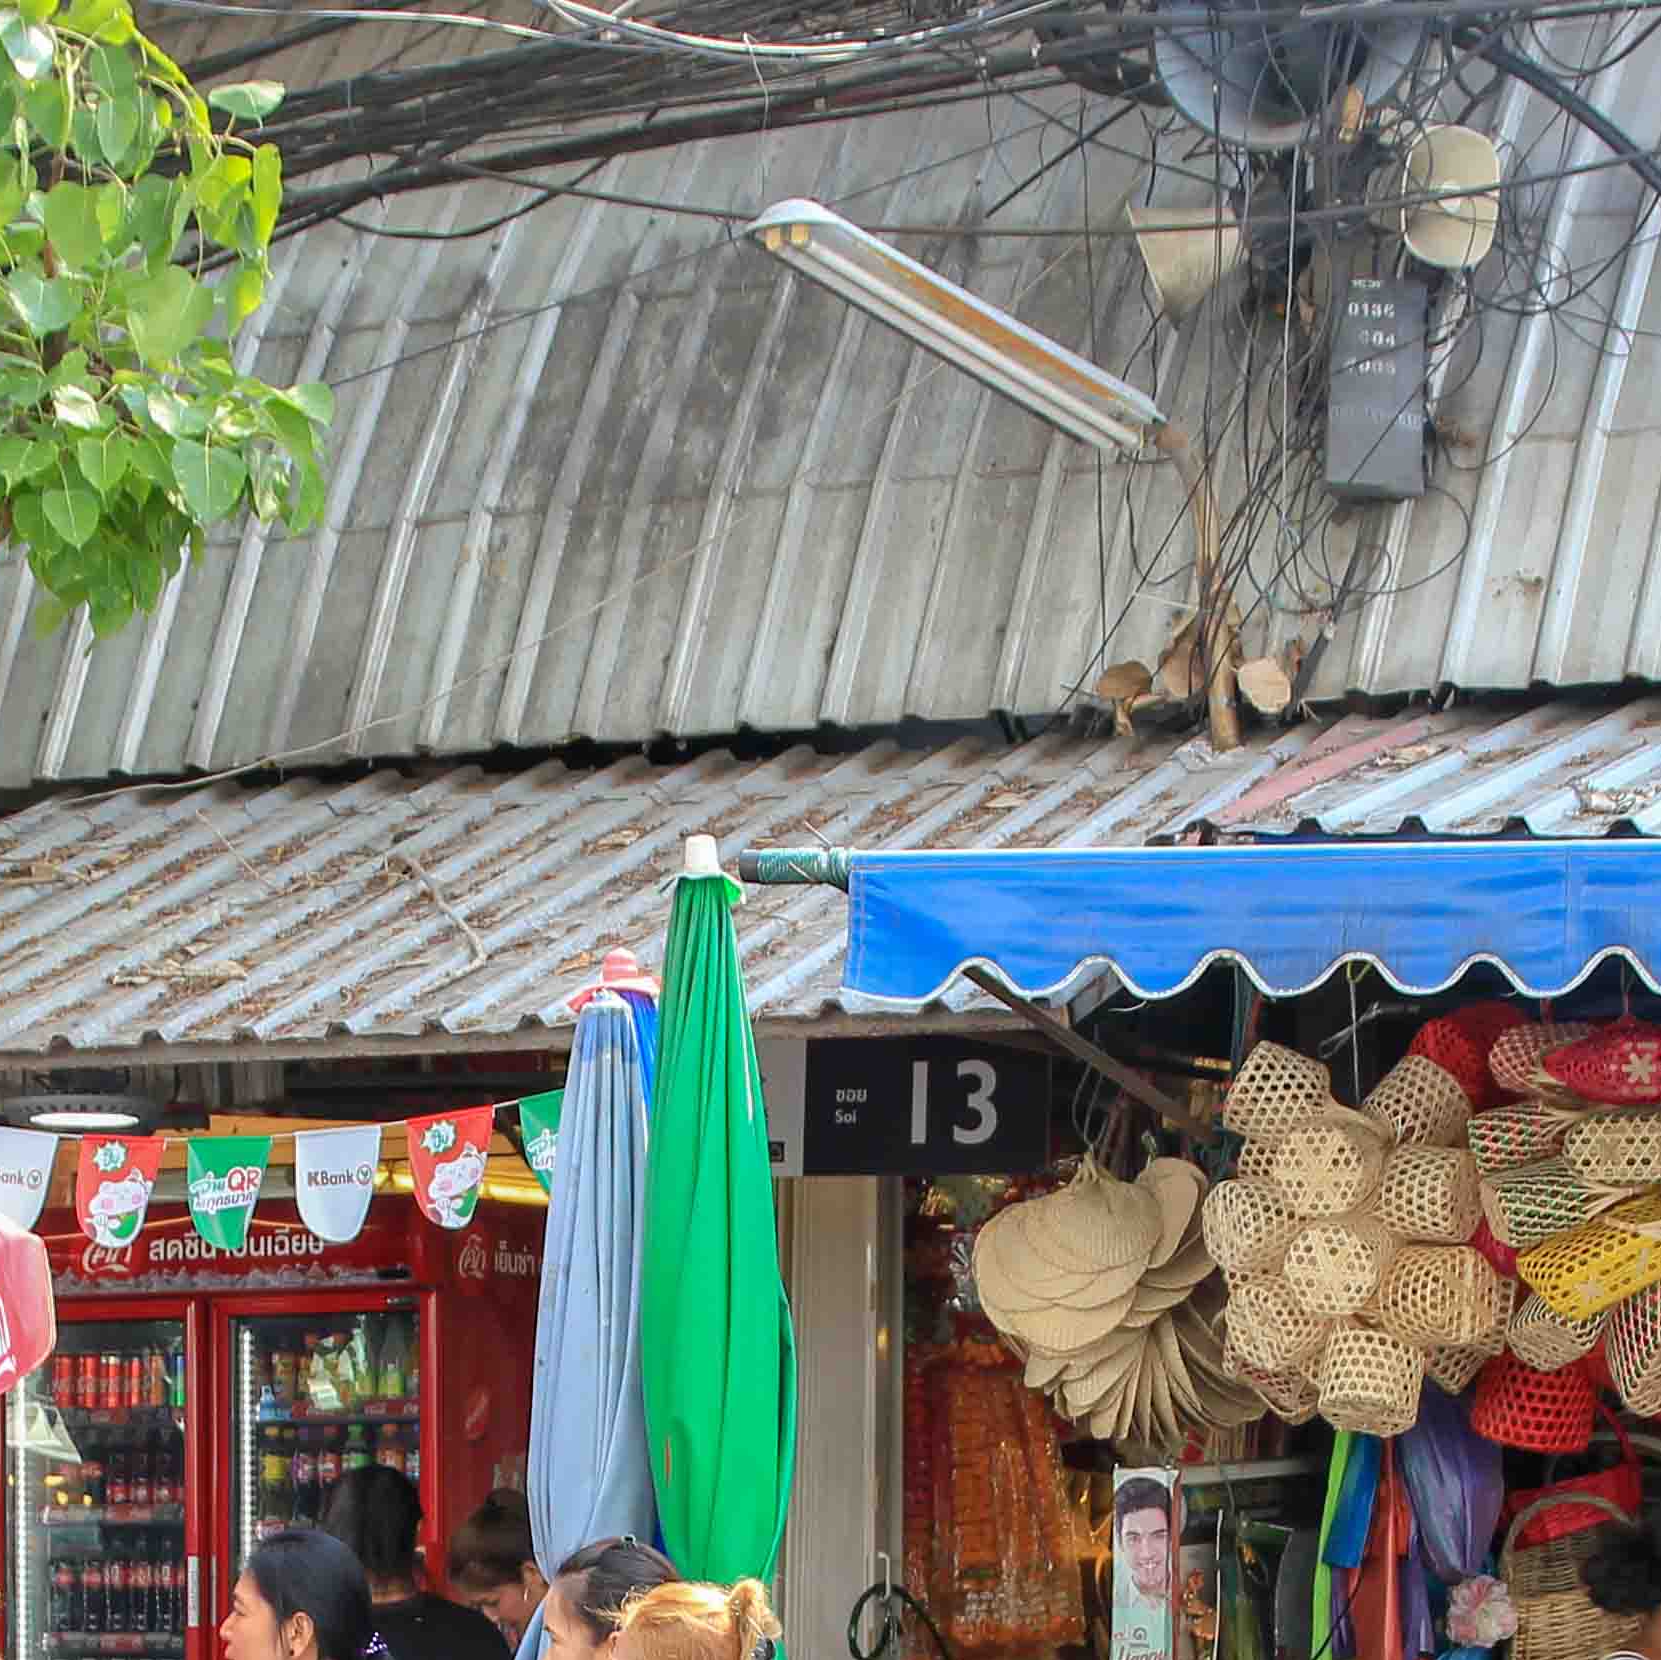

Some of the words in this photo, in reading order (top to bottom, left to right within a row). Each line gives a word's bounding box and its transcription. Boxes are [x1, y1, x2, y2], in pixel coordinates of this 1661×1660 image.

[835, 1087, 868, 1103] ซอย
[910, 1059, 998, 1145] 13
[835, 1109, 857, 1124] Soi
[307, 1169, 355, 1188] KBank
